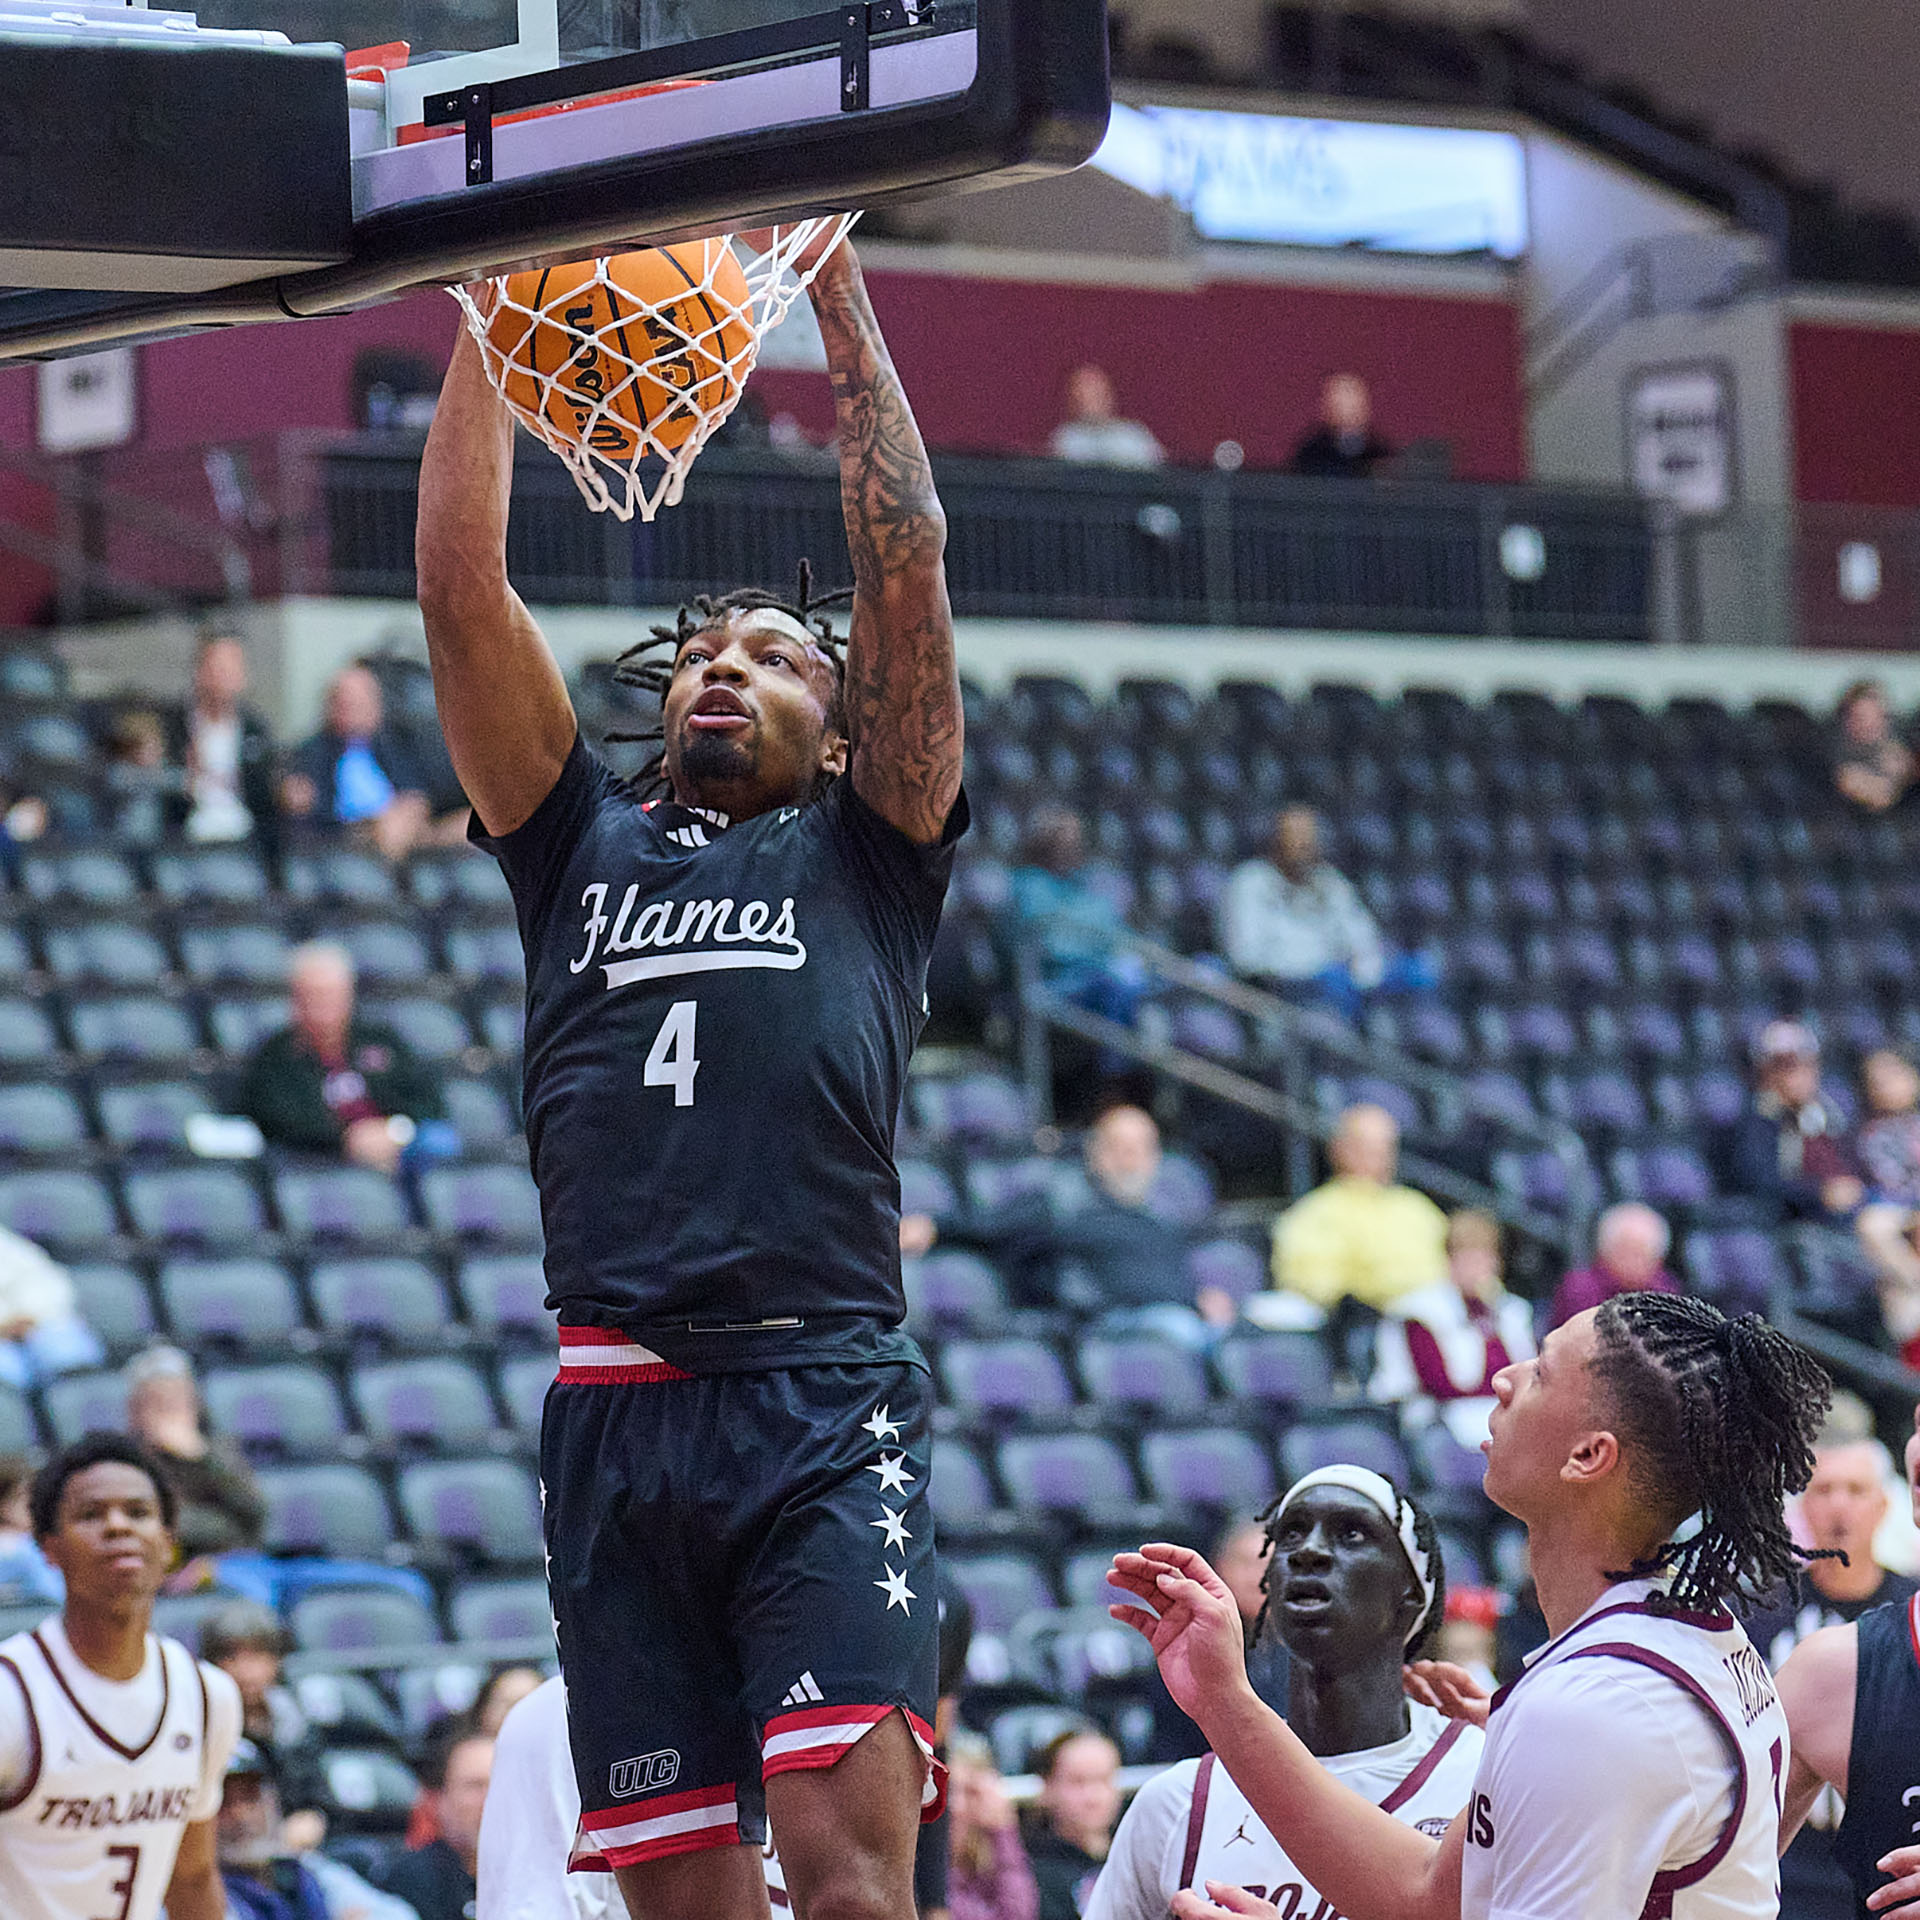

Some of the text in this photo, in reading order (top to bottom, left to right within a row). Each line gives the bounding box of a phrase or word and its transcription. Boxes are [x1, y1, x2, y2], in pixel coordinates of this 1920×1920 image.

[565, 303, 630, 451] Wilson
[642, 305, 701, 425] NCAA
[569, 882, 804, 975] Flames
[643, 1000, 701, 1107] 4
[38, 1785, 196, 1829] TROJANS
[611, 1750, 678, 1796] UIC
[90, 1844, 140, 1920] 3
